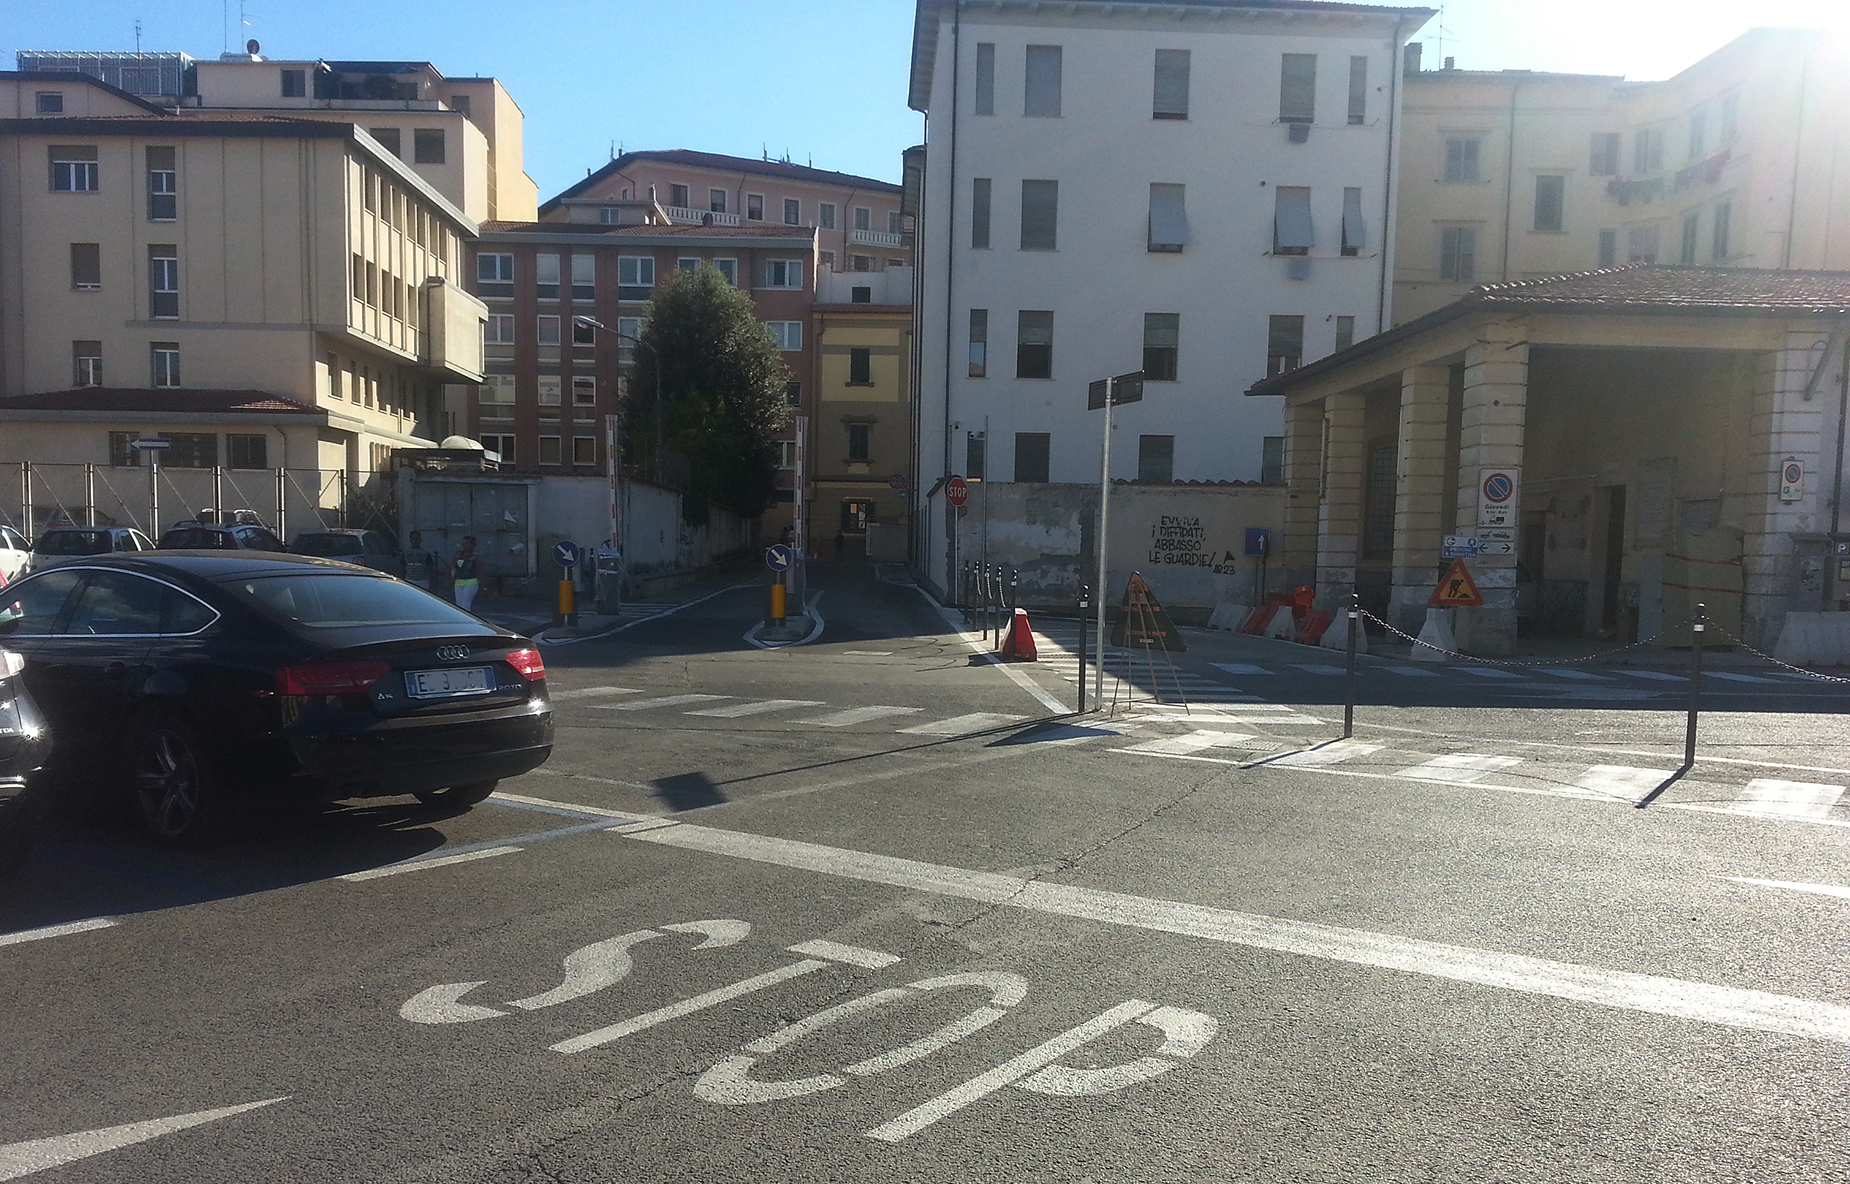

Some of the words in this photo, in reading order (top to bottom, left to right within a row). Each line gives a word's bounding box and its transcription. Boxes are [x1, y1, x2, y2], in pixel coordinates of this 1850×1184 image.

[949, 490, 967, 498] STOP
[1154, 539, 1202, 551] ABBASSO
[1838, 544, 1846, 552] P
[1149, 551, 1161, 563] LE
[400, 919, 1219, 1141] STOP
